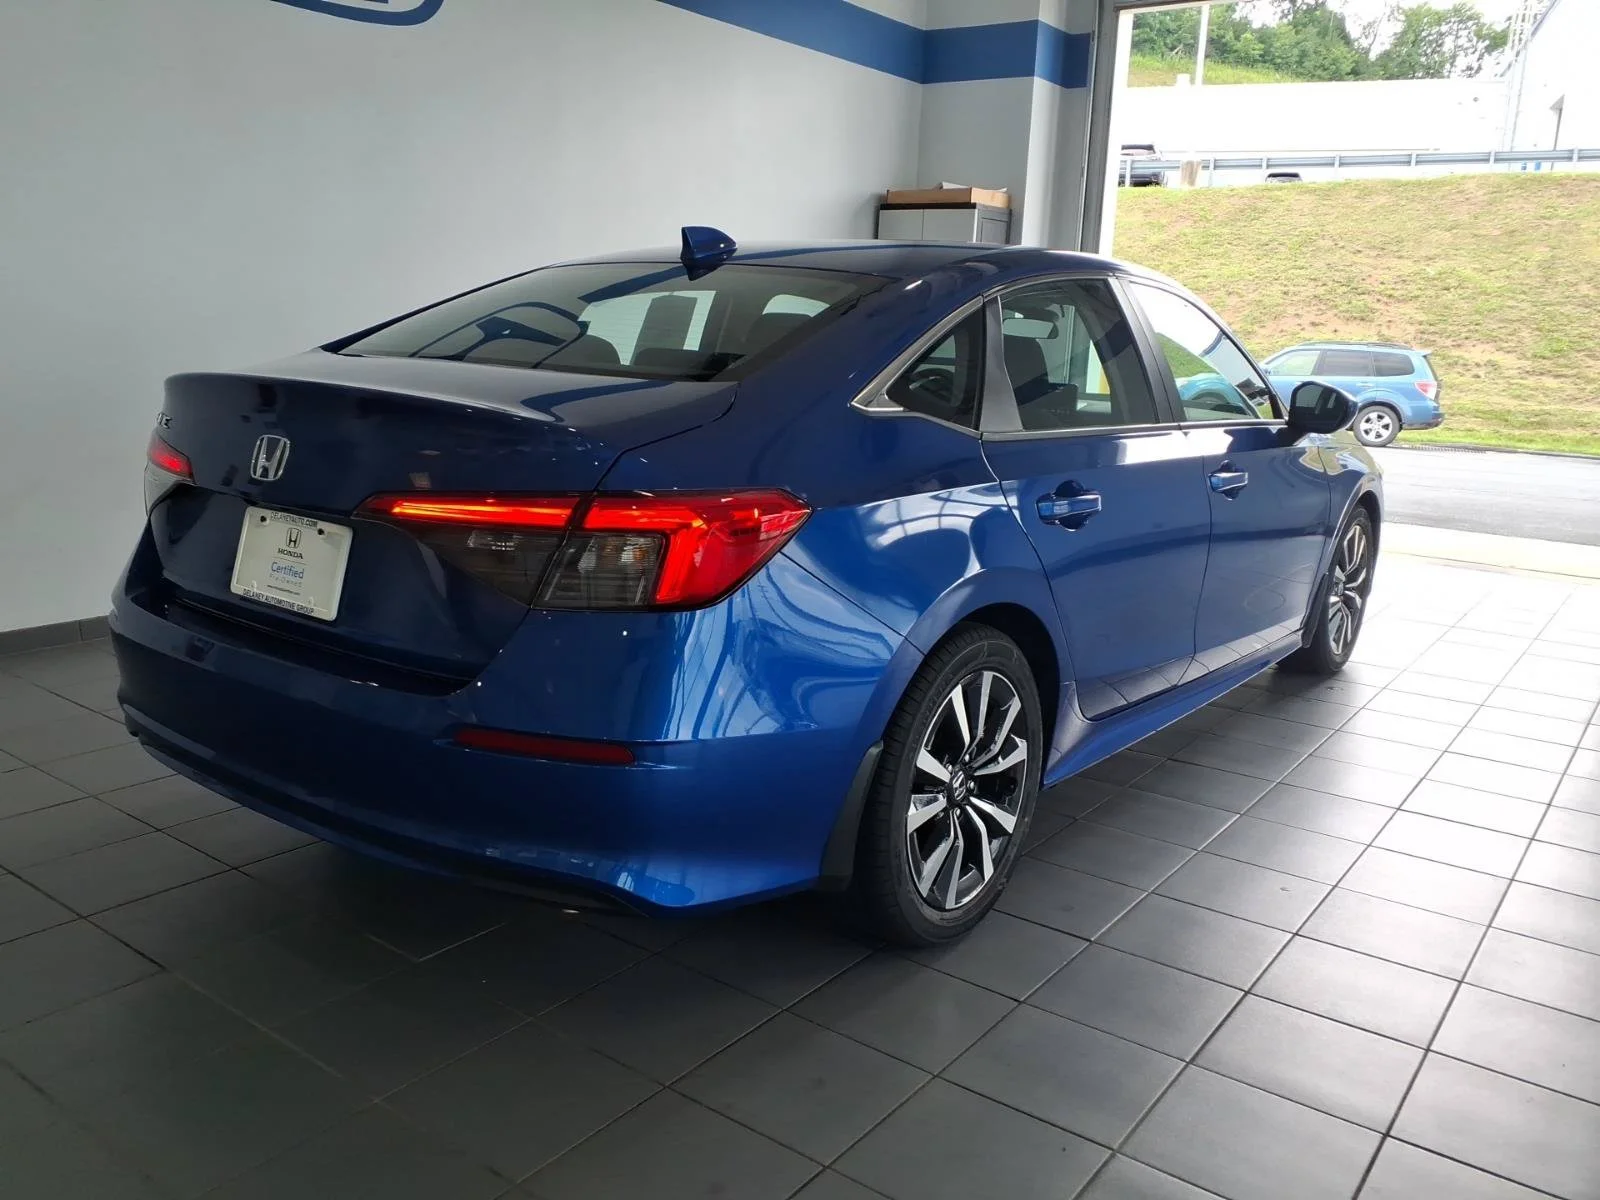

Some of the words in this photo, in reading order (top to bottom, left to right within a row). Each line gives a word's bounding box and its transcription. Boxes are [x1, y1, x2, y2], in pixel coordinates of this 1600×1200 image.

[270, 511, 318, 528] DELANEYAUTO.COM
[277, 548, 304, 559] HONDA
[271, 561, 304, 579] Certified
[242, 588, 265, 601] DELANEY
[264, 594, 297, 611] AUTOMOTIVE
[296, 603, 315, 615] GROUP
